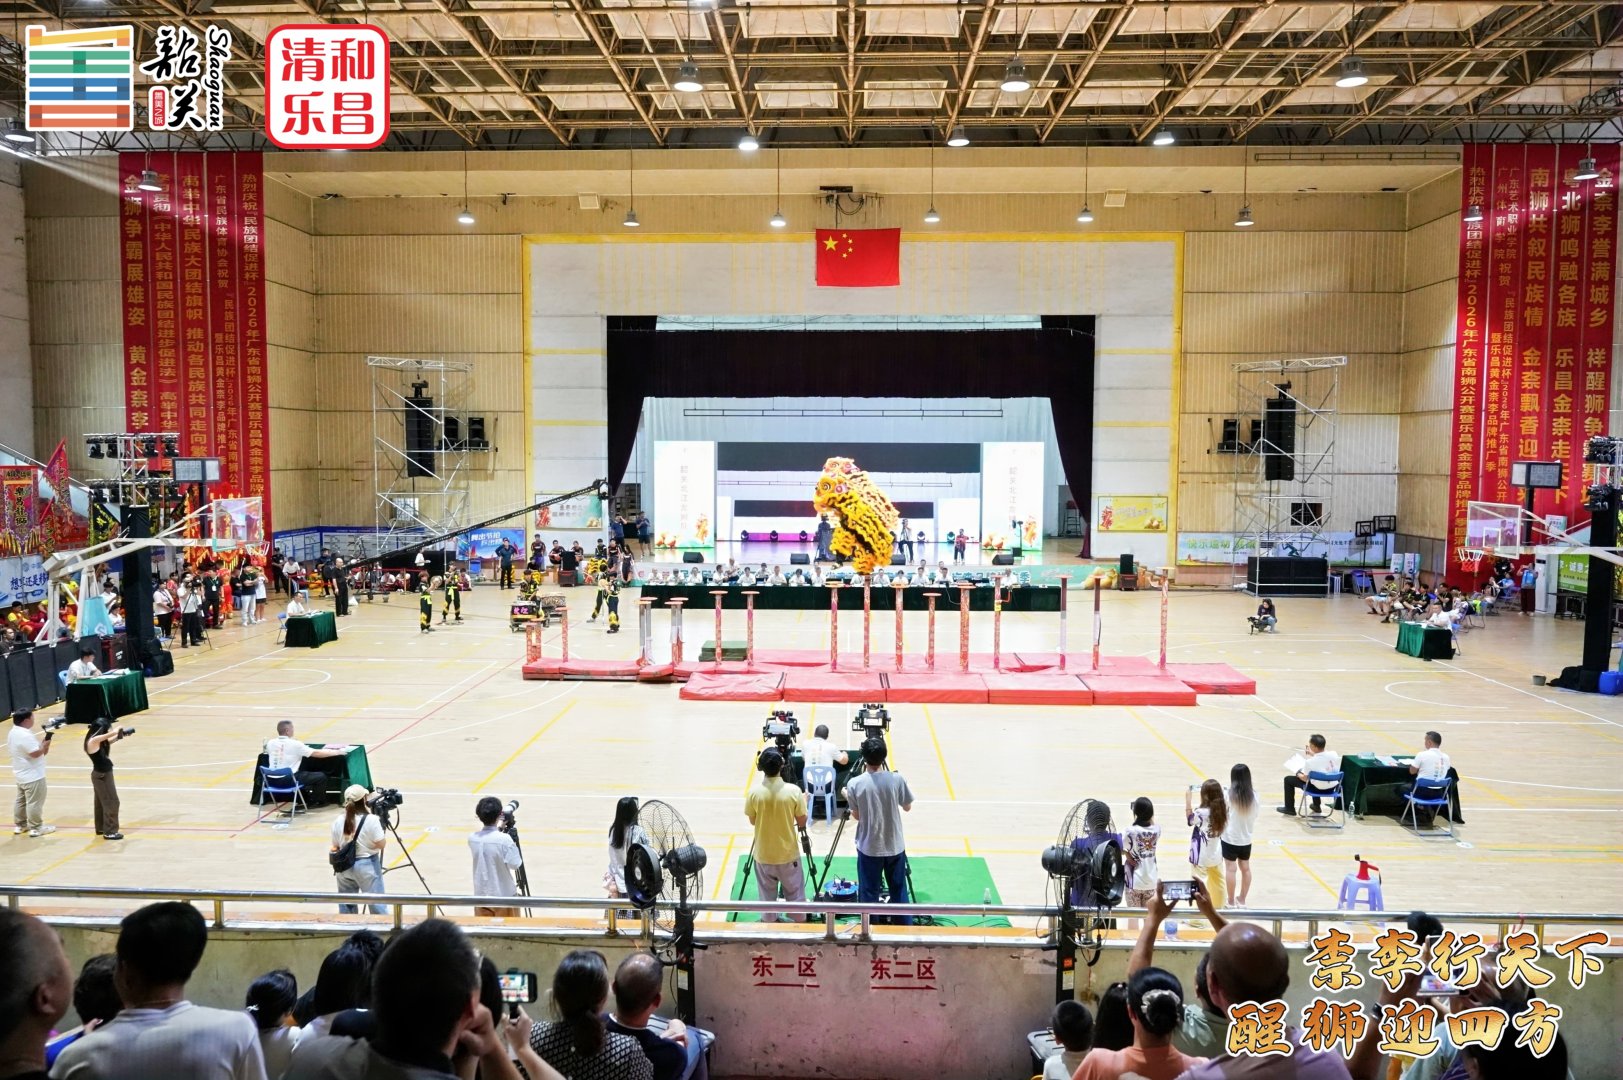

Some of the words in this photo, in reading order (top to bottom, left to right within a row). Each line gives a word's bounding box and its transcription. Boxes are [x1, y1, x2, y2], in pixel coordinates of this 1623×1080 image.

[124, 174, 145, 327] 金狮争霸展雄姿
[182, 174, 204, 321] 高举中华民族大团结旗帜
[1499, 263, 1512, 287] 祝贺
[1524, 167, 1550, 328] 南狮共叙民族情
[1589, 167, 1614, 328] 金柰李誉满城乡
[1517, 346, 1541, 501] 金柰飘香迎
[1580, 347, 1606, 503] 祥醒狮争赛
[752, 955, 817, 978] 东一区
[870, 959, 936, 981] 东二区
